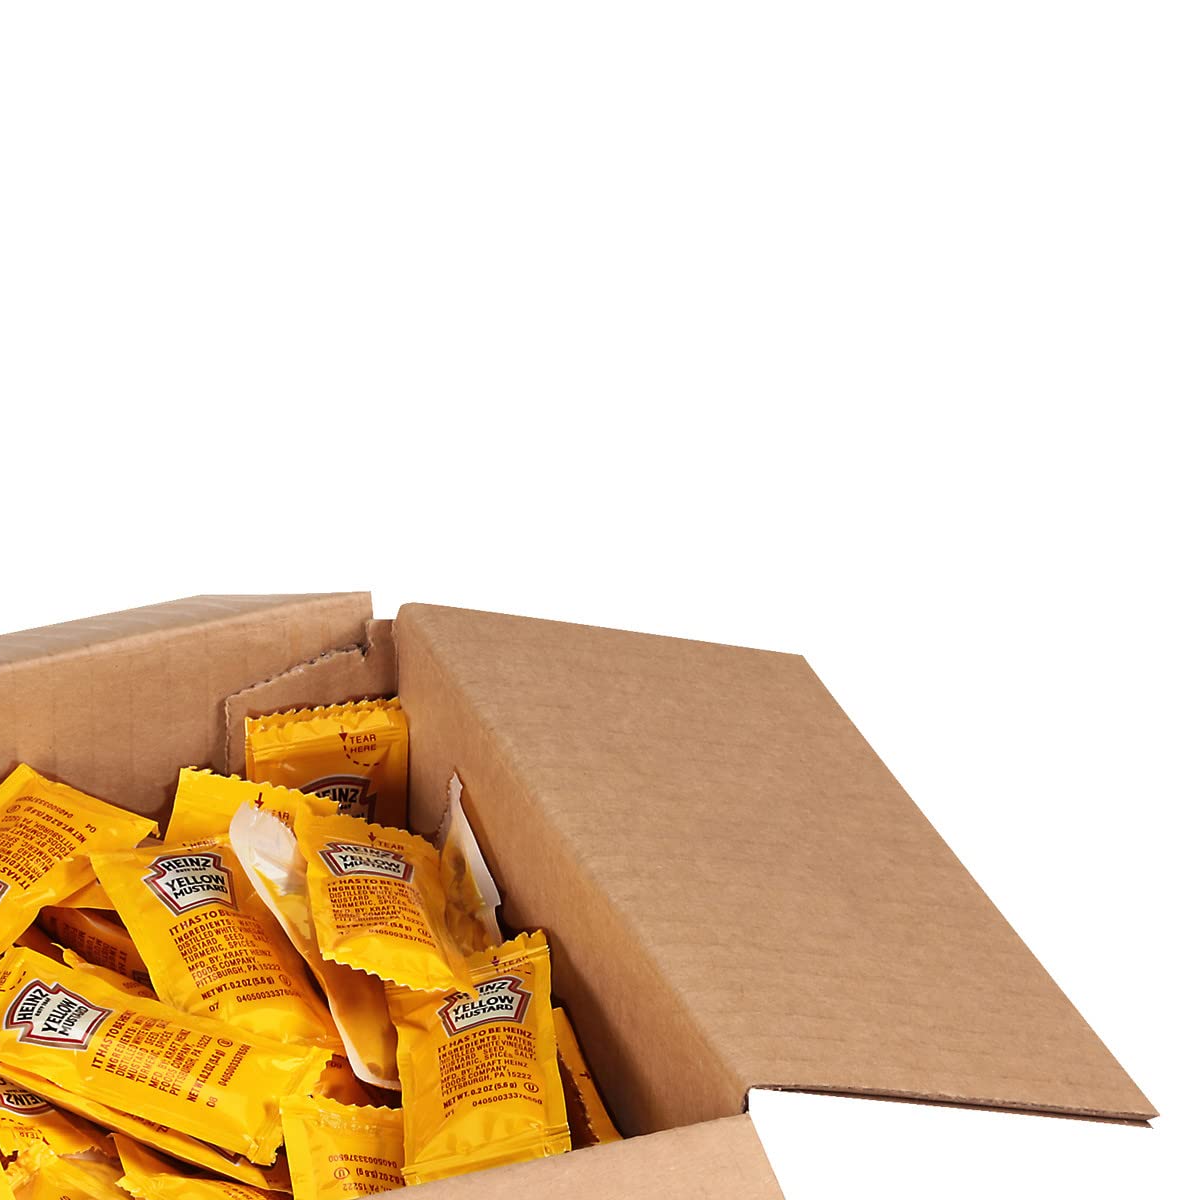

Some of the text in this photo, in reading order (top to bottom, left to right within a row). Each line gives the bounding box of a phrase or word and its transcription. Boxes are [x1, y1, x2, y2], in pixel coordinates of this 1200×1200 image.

[350, 734, 376, 744] TEAR
[350, 744, 376, 753] HERE
[379, 841, 404, 850] TEAR
[161, 858, 211, 871] HEINZ
[339, 855, 400, 869] YELLOW
[343, 860, 401, 874] MUSTARD
[0, 870, 20, 882] HAS
[165, 875, 225, 891] YELLOW
[19, 879, 30, 890] IT
[173, 884, 228, 899] MUSTARD
[169, 911, 217, 936] IT HAS TO
[178, 927, 236, 951] DISTILLED WHITE
[181, 938, 217, 957] MUSTARD
[224, 949, 249, 960] KRAFT
[191, 966, 218, 981] FOODS
[248, 963, 258, 971] PA
[201, 989, 216, 1000] NET
[216, 983, 229, 993] WT.
[230, 980, 242, 989] 0.2
[243, 978, 251, 986] OZ
[17, 989, 49, 1021] HEINZ
[209, 1002, 219, 1011] 07
[453, 996, 514, 1015] YELLOW
[42, 998, 77, 1032] YELLOW
[454, 1004, 513, 1022] MUSTARD
[58, 1006, 88, 1036] MUSTARD
[106, 1028, 119, 1038] TO
[96, 1038, 112, 1057] HAS
[438, 1045, 447, 1053] IT
[450, 1035, 469, 1047] HAS
[472, 1030, 486, 1038] TO
[440, 1048, 475, 1066] DISTILLED
[477, 1040, 499, 1050] WHITE
[91, 1057, 103, 1068] IT
[440, 1053, 476, 1071] MUSTARD
[476, 1059, 501, 1070] KRAFT
[504, 1059, 528, 1068] HEINZ
[441, 1076, 466, 1090] FOODS
[508, 1072, 532, 1080] 15222
[187, 1088, 200, 1103] NET
[444, 1097, 456, 1109] NET
[457, 1091, 470, 1099] WT.
[471, 1087, 482, 1095] 0.2
[494, 1082, 508, 1090] (5.6
[379, 1173, 389, 1181] OZ
